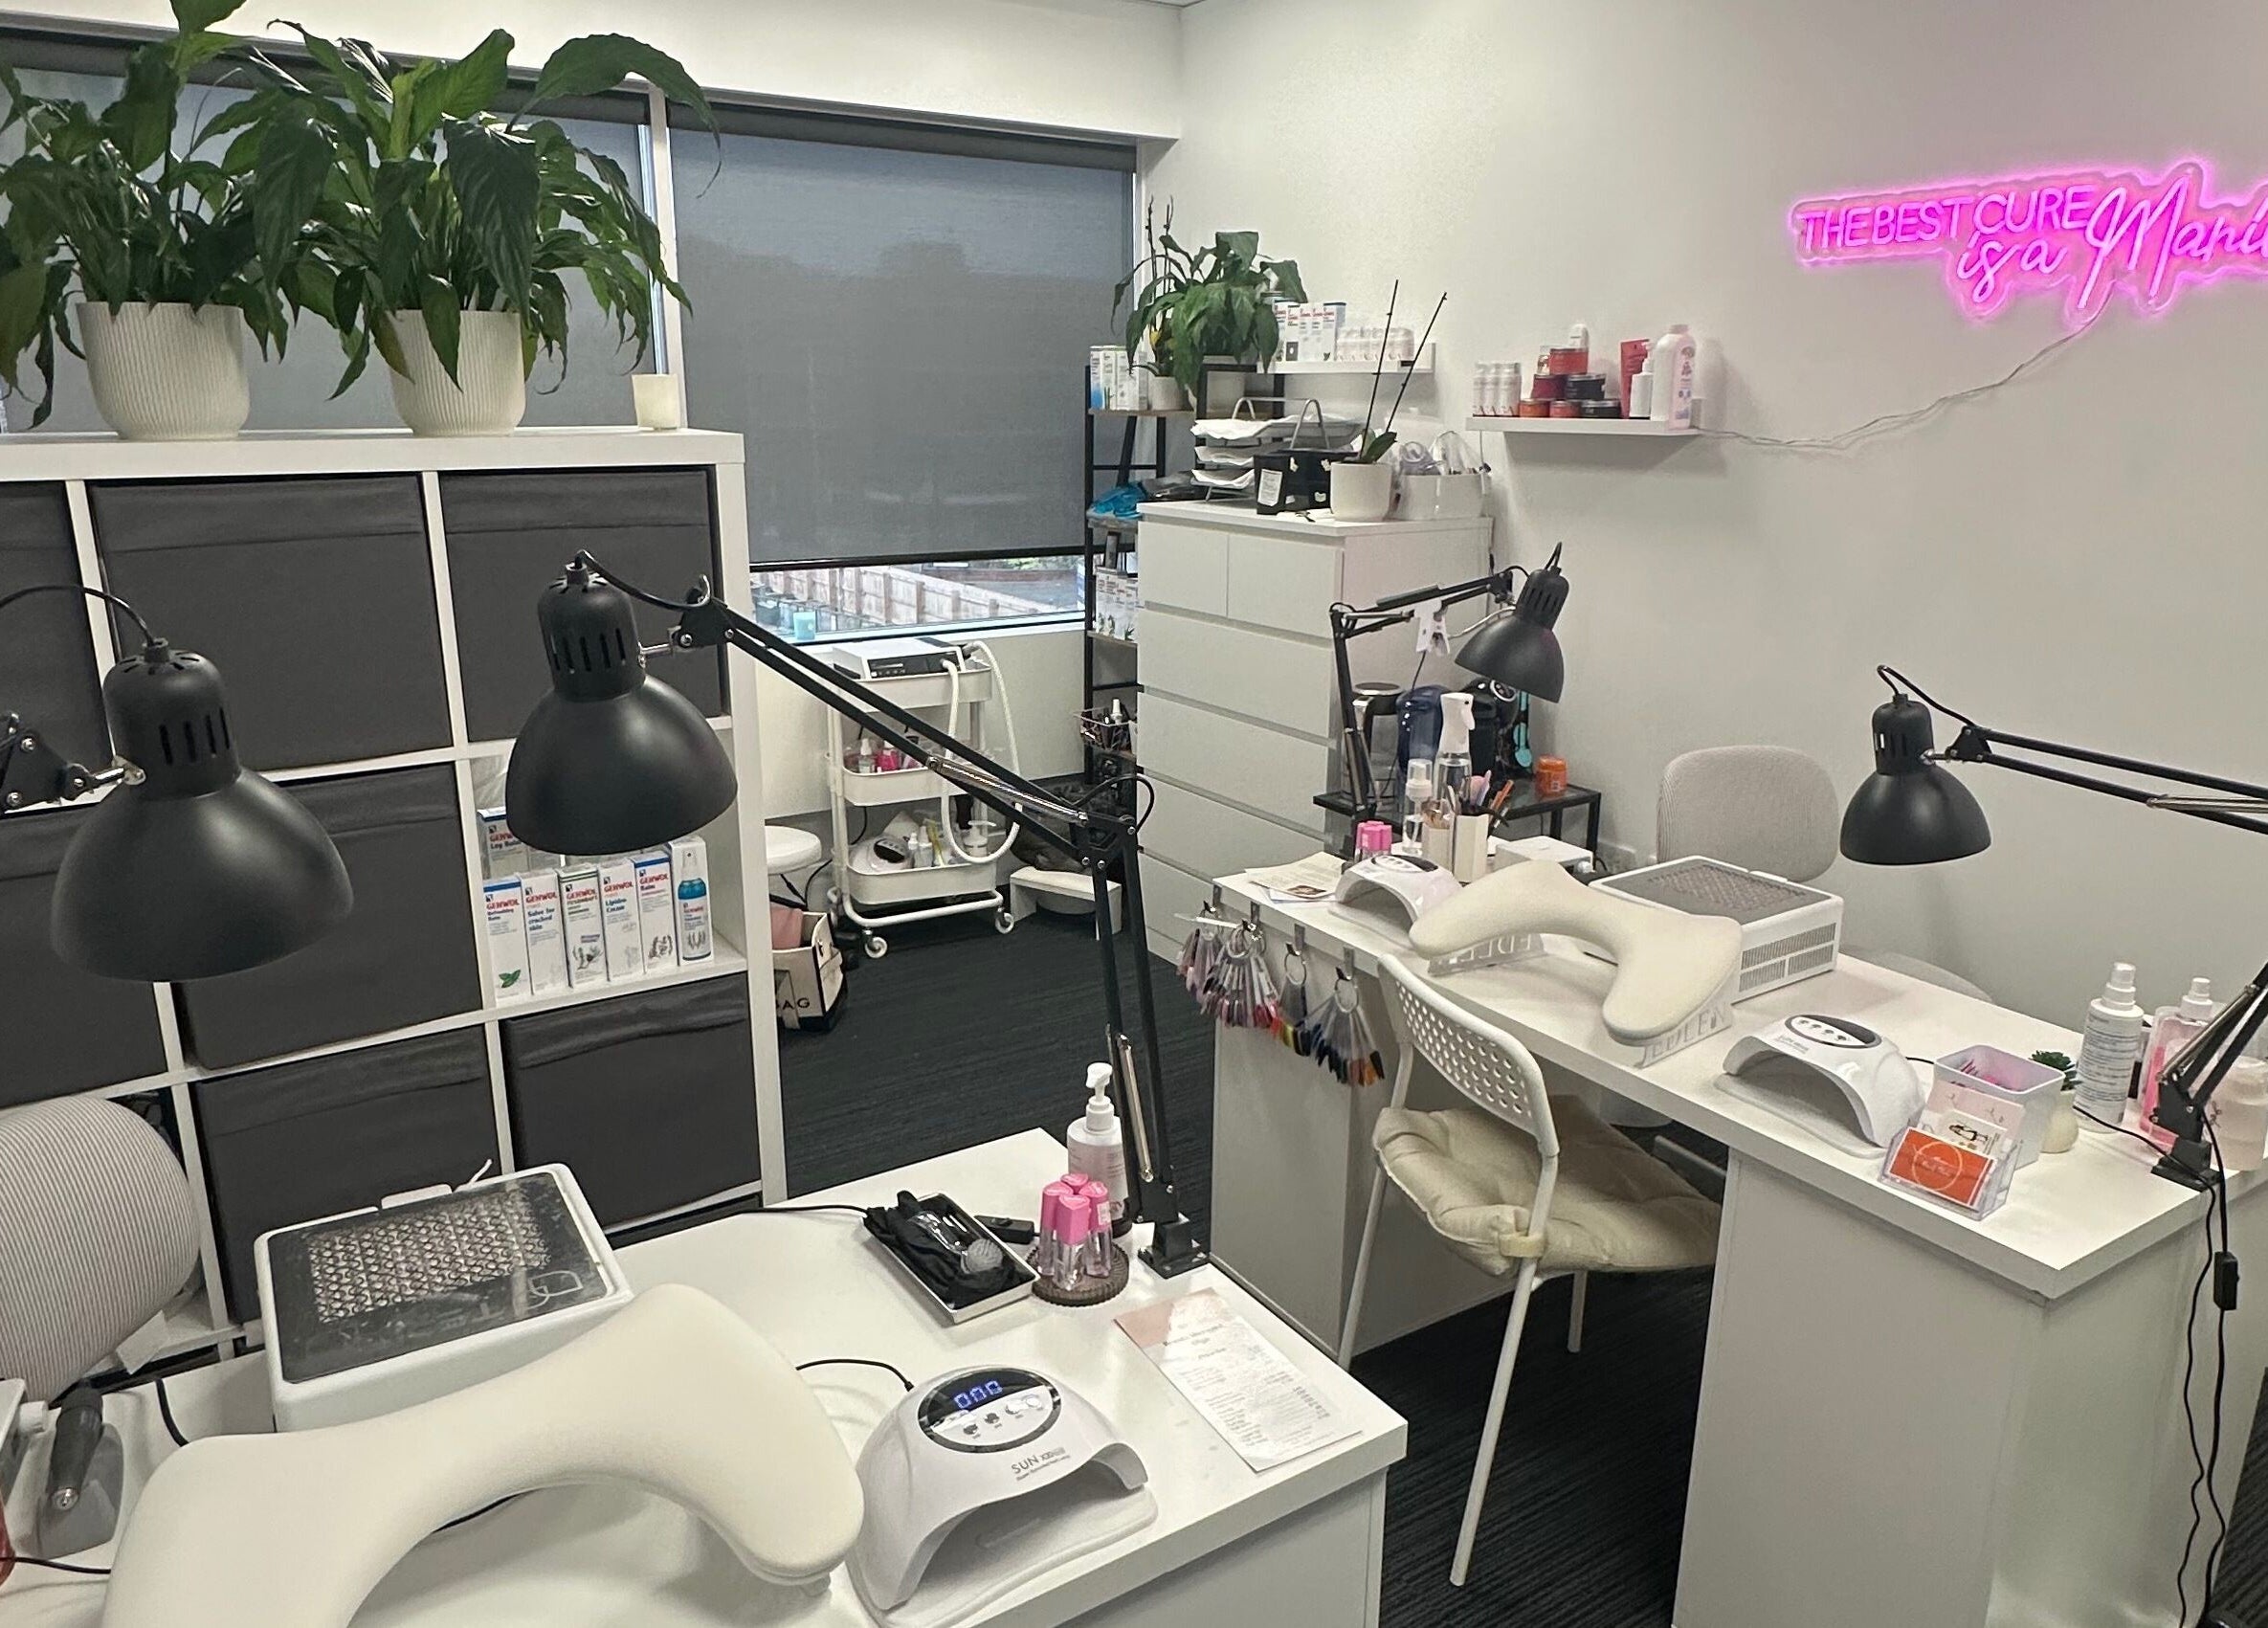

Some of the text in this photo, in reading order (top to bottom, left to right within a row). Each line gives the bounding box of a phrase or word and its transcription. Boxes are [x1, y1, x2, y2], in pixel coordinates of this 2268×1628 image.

[1796, 185, 2096, 253] THE BEST CURE
[1957, 176, 2268, 307] is a Mani
[489, 832, 514, 843] GEHW
[1012, 1455, 1040, 1474] SUN
